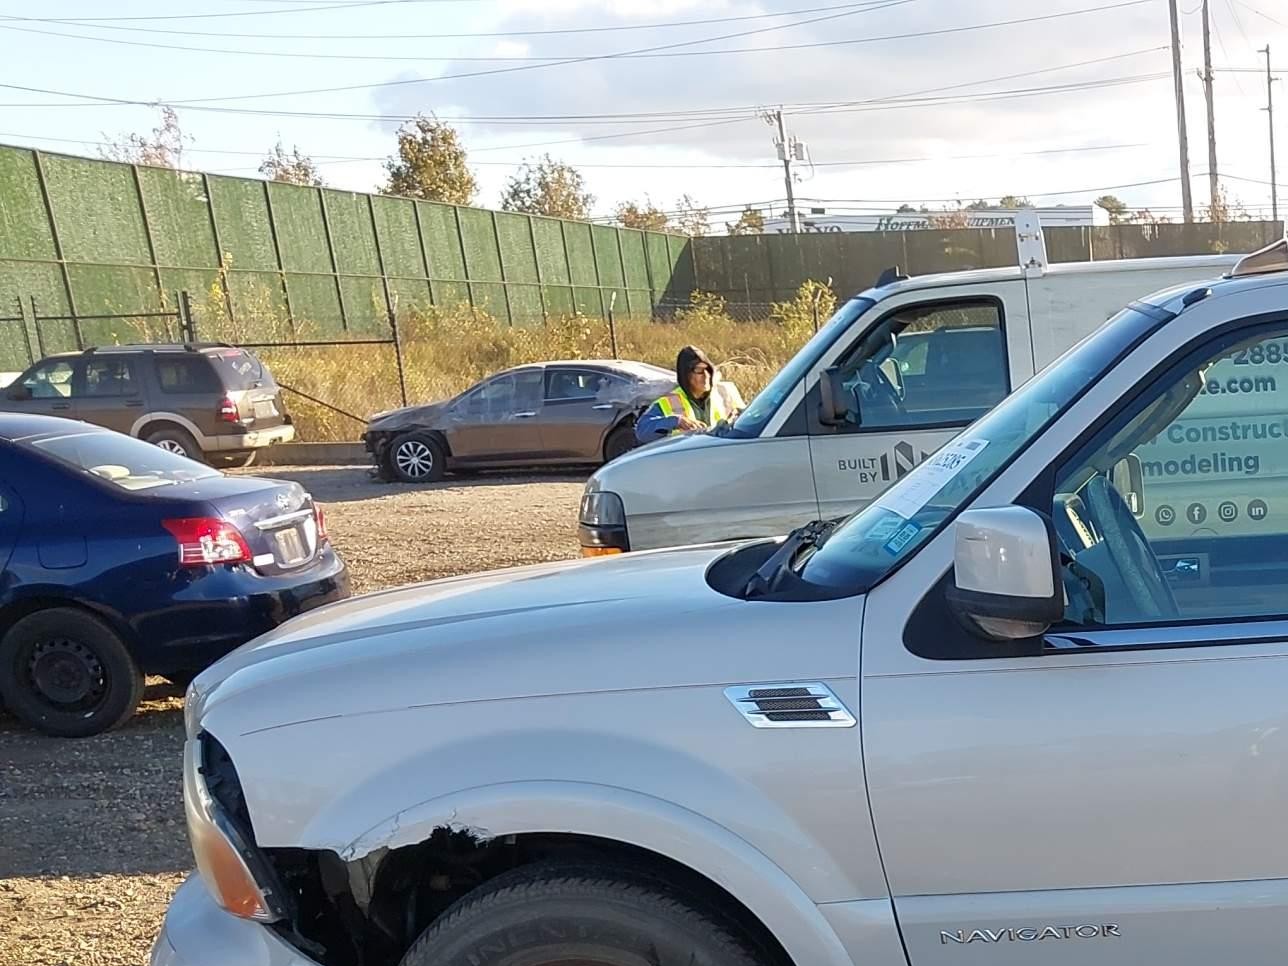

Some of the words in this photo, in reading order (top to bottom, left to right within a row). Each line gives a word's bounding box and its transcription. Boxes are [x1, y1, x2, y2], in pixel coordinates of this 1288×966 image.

[838, 459, 877, 471] BUILT
[860, 472, 878, 483] BY
[940, 922, 1121, 944] NAVIGATOR
